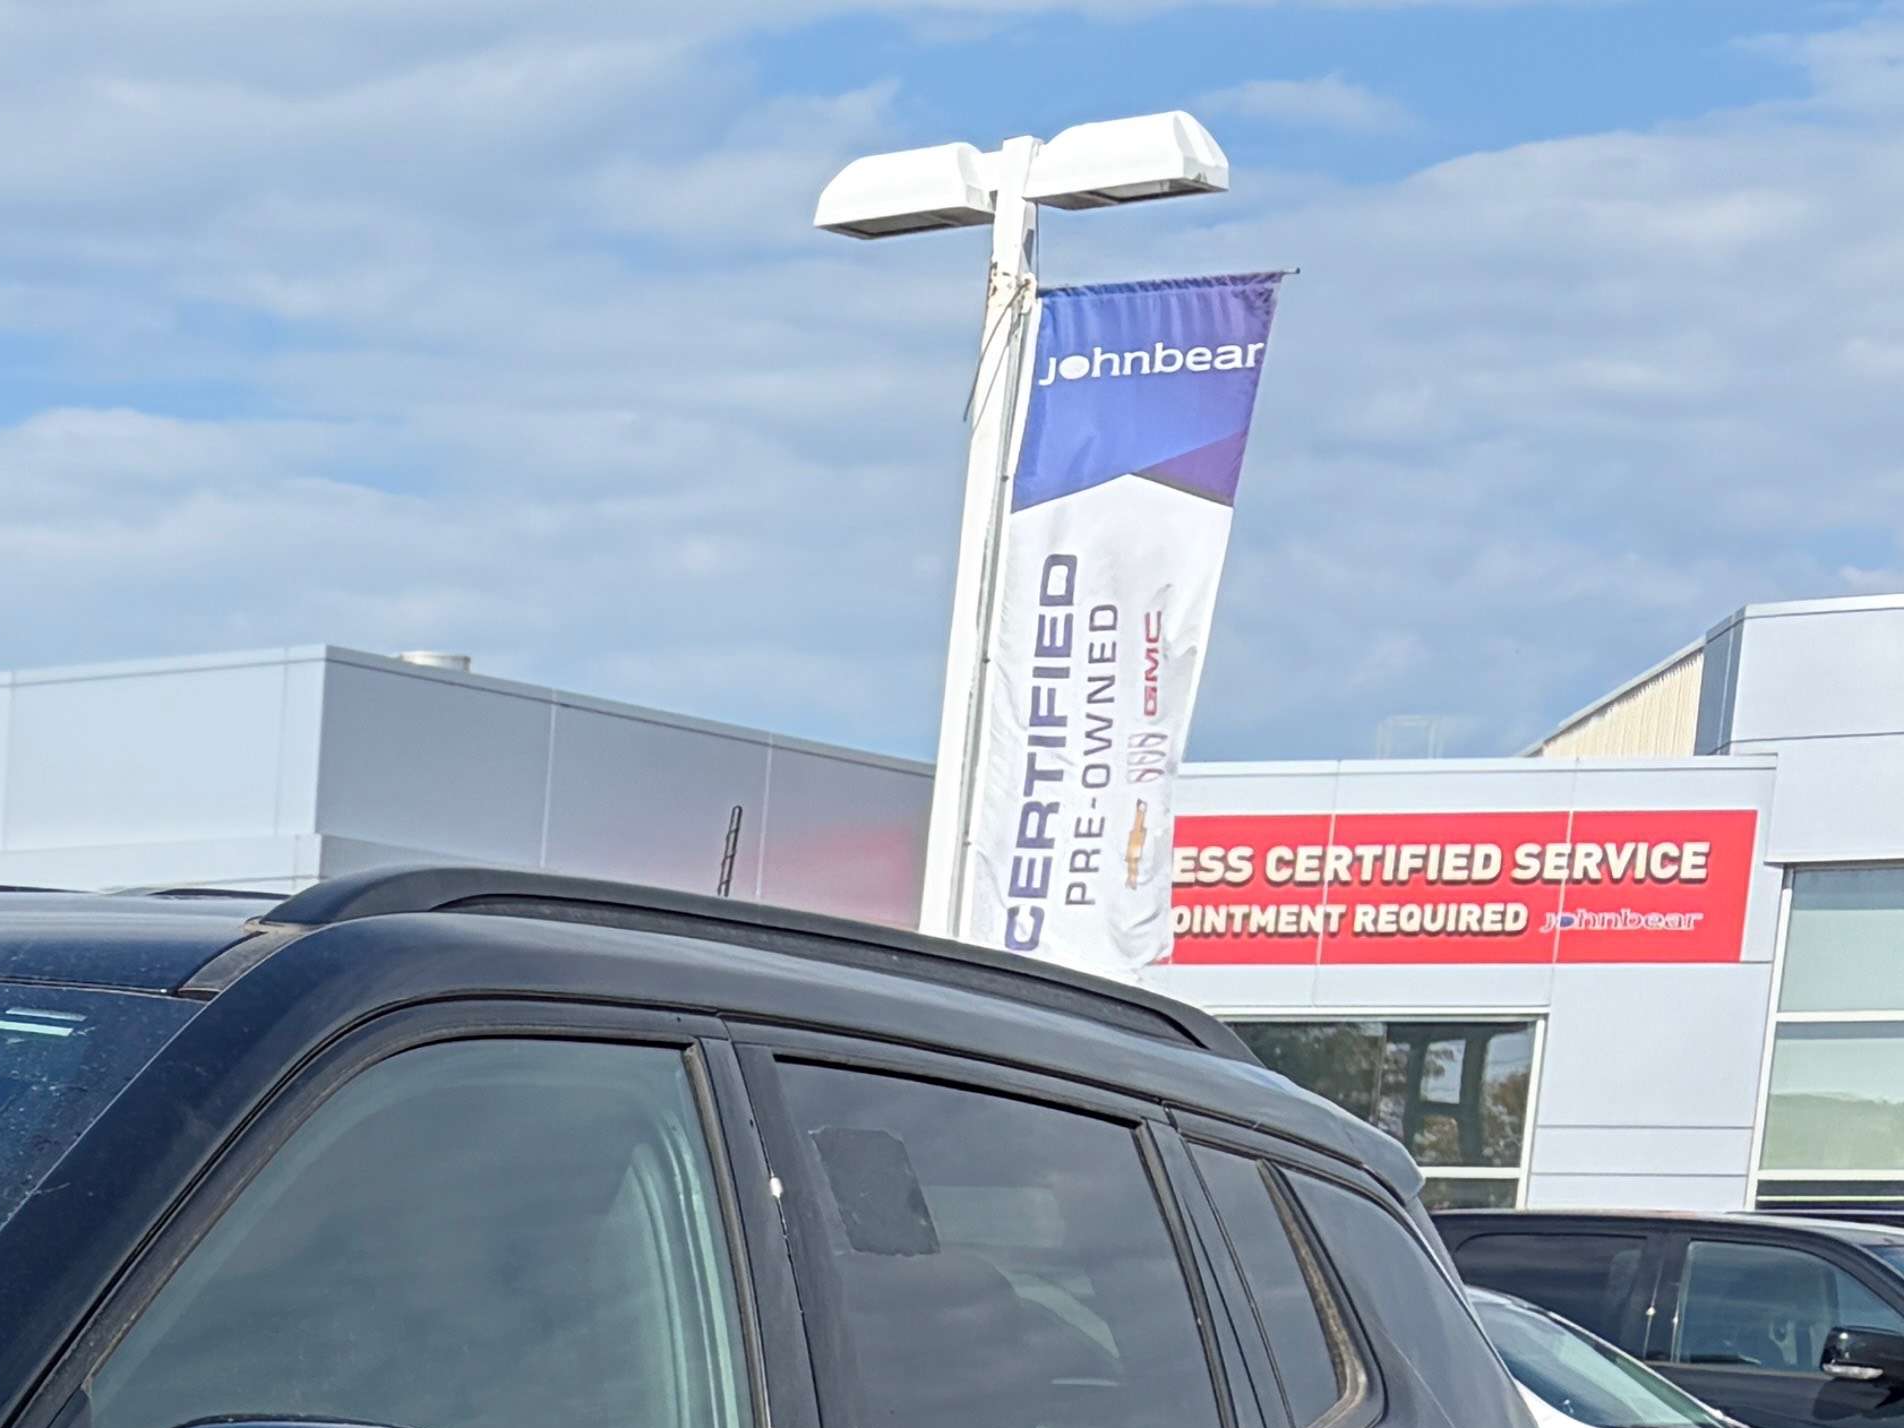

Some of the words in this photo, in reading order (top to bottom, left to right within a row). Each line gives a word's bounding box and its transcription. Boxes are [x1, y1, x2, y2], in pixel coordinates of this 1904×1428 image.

[1143, 610, 1163, 717] GMC
[1003, 553, 1078, 952] CERTIFIED
[1064, 603, 1119, 906] PRE-OWNED
[1265, 843, 1503, 885] CERTIFIED
[1511, 841, 1711, 884] SERVICE
[1353, 902, 1529, 934] REQUIRED
